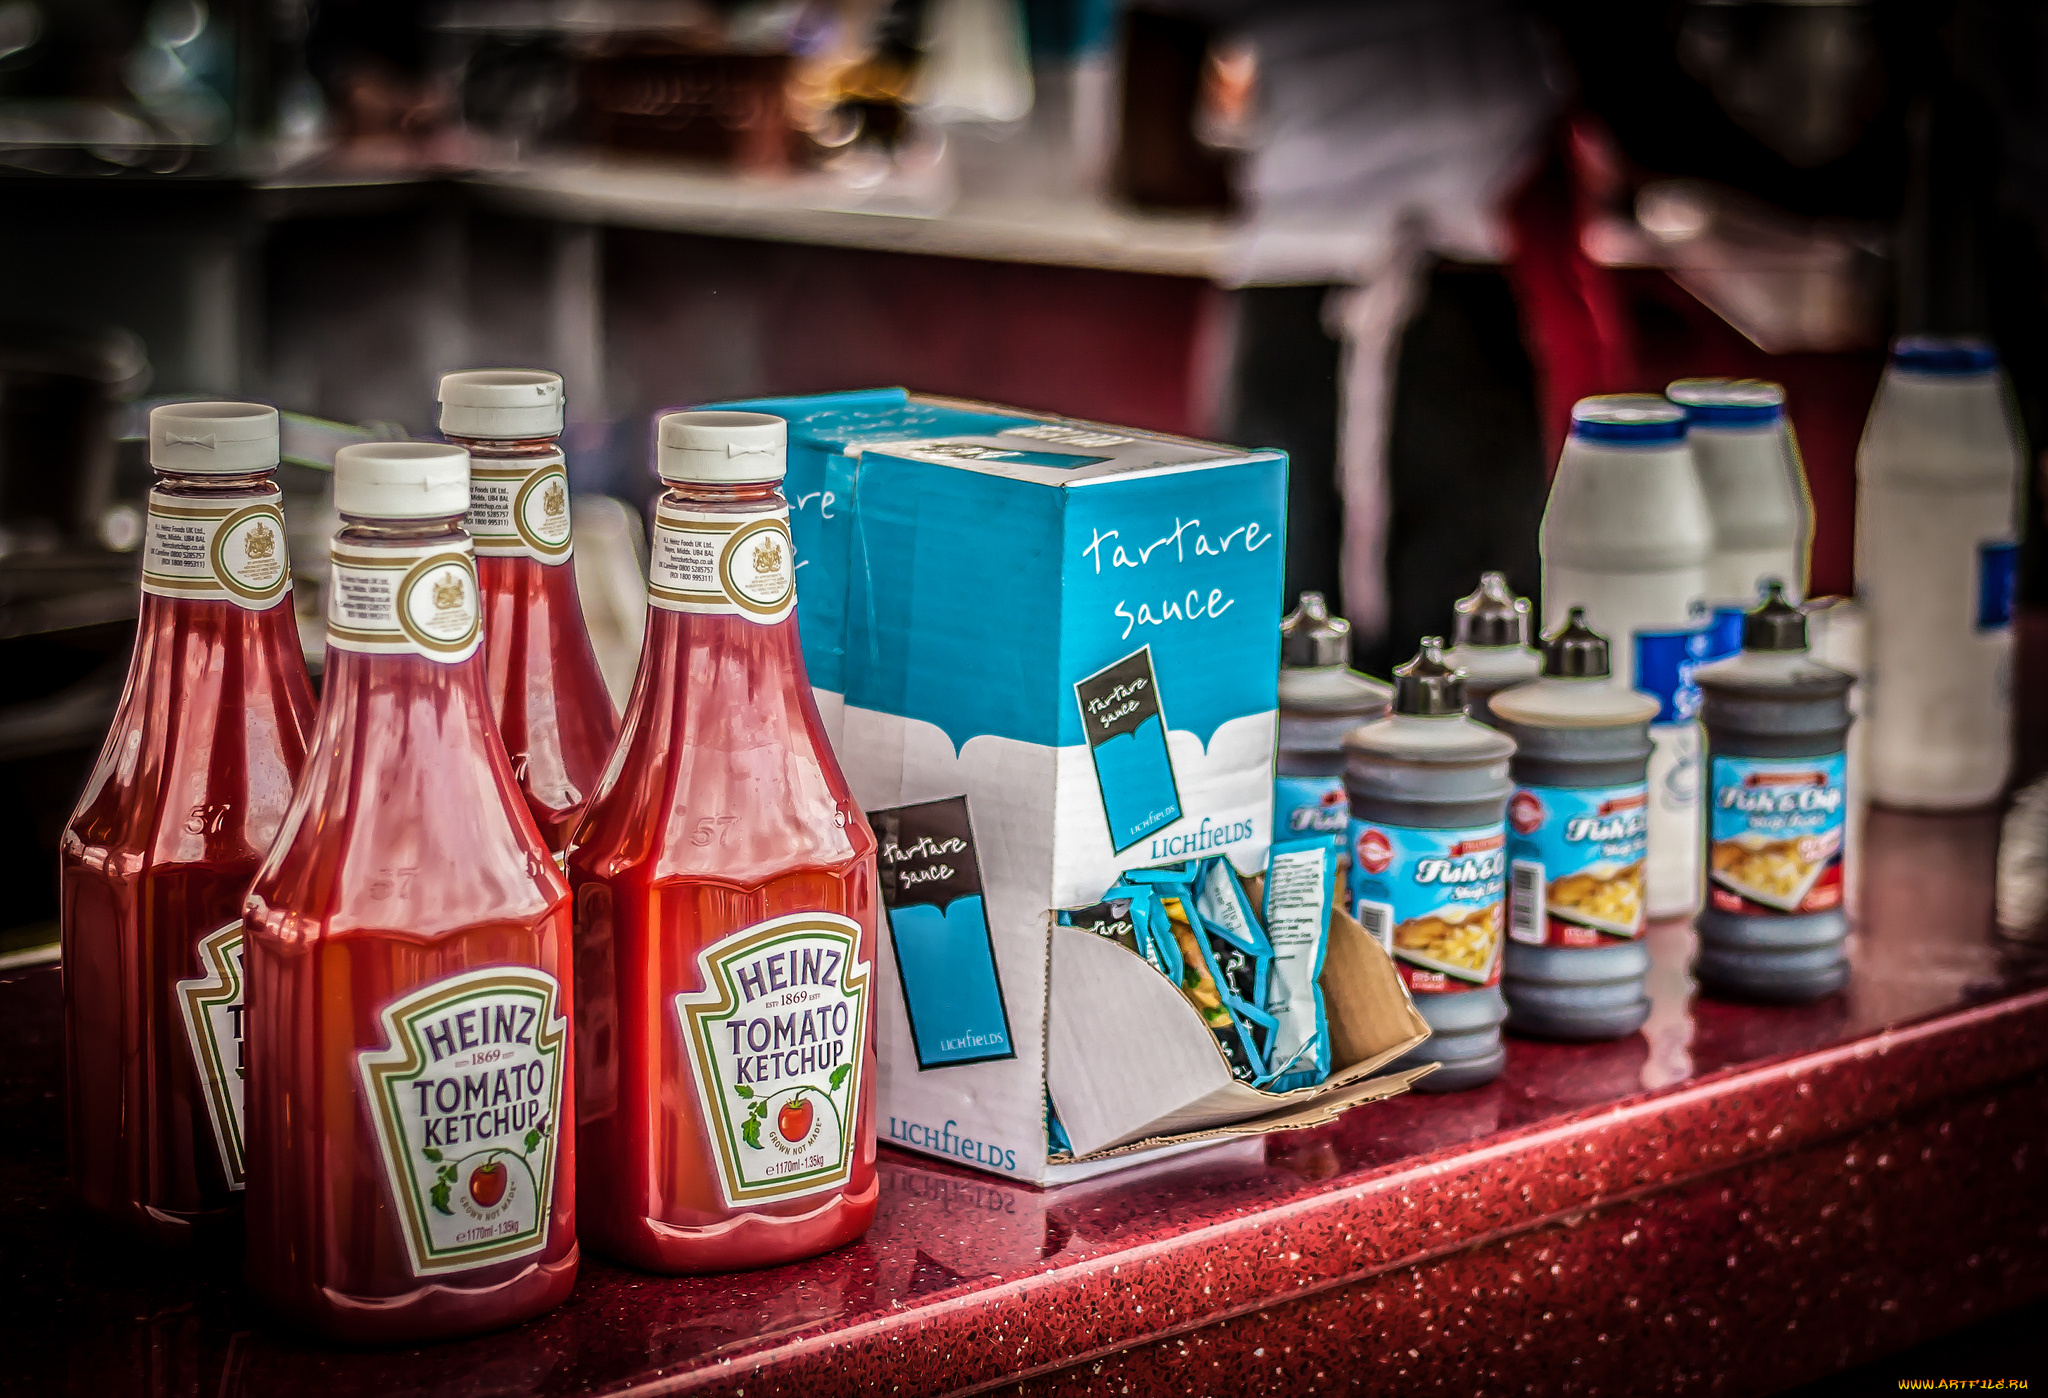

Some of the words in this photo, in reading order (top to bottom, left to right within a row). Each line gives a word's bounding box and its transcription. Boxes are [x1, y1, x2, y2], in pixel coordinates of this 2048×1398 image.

[1083, 517, 1272, 574] tartare
[1114, 588, 1234, 640] sauce
[1088, 678, 1148, 714] tartare
[1100, 700, 1140, 729] sauce
[884, 836, 967, 864] tartare
[899, 864, 955, 889] sauce
[1416, 859, 1478, 883] Fish
[1089, 920, 1132, 935] tare
[737, 948, 842, 1003] HEINZ
[781, 991, 807, 1006] 1869
[424, 1004, 537, 1062] HEINZ
[726, 1001, 848, 1054] TOMATO
[472, 1049, 500, 1065] 1869
[737, 1040, 844, 1084] KETCHUP
[412, 1059, 545, 1117] TOMATO
[424, 1099, 539, 1148] KETCHUP
[769, 1131, 791, 1155] GROWN
[792, 1144, 807, 1156] NOT
